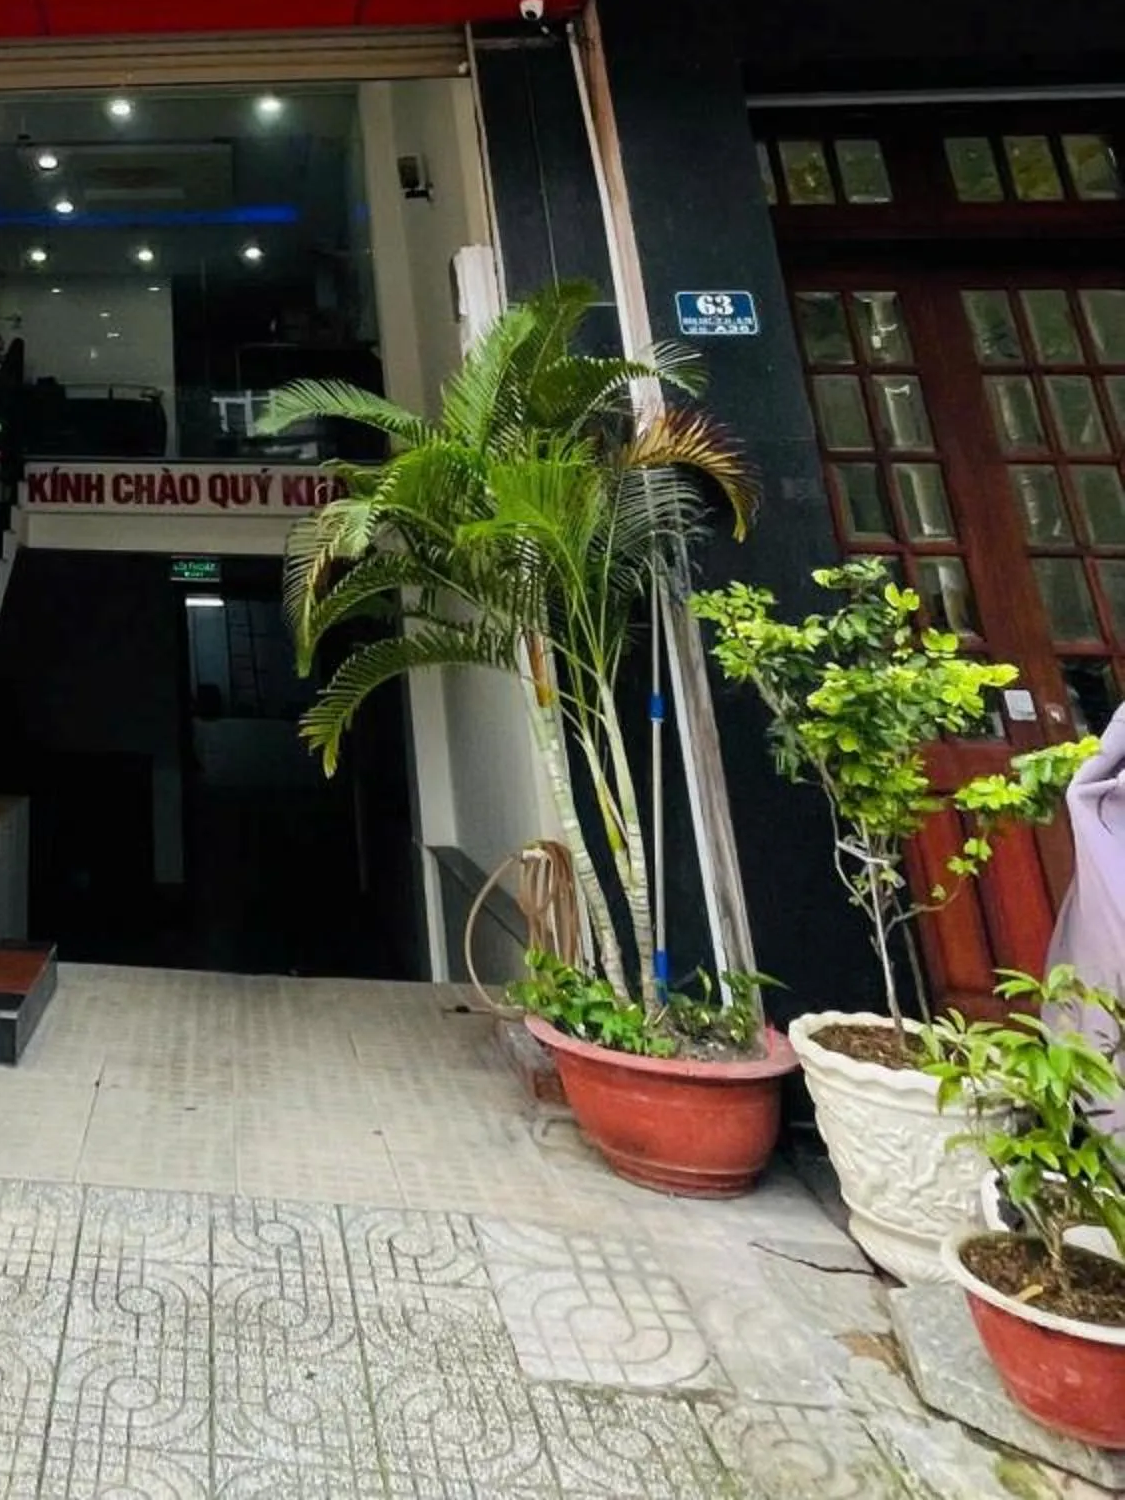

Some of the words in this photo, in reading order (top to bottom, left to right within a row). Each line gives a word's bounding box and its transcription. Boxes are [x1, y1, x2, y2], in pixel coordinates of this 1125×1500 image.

[696, 295, 734, 315] 63
[27, 466, 105, 504] KÍNH
[111, 467, 201, 505] CHÀO
[207, 467, 273, 509] QUÝ
